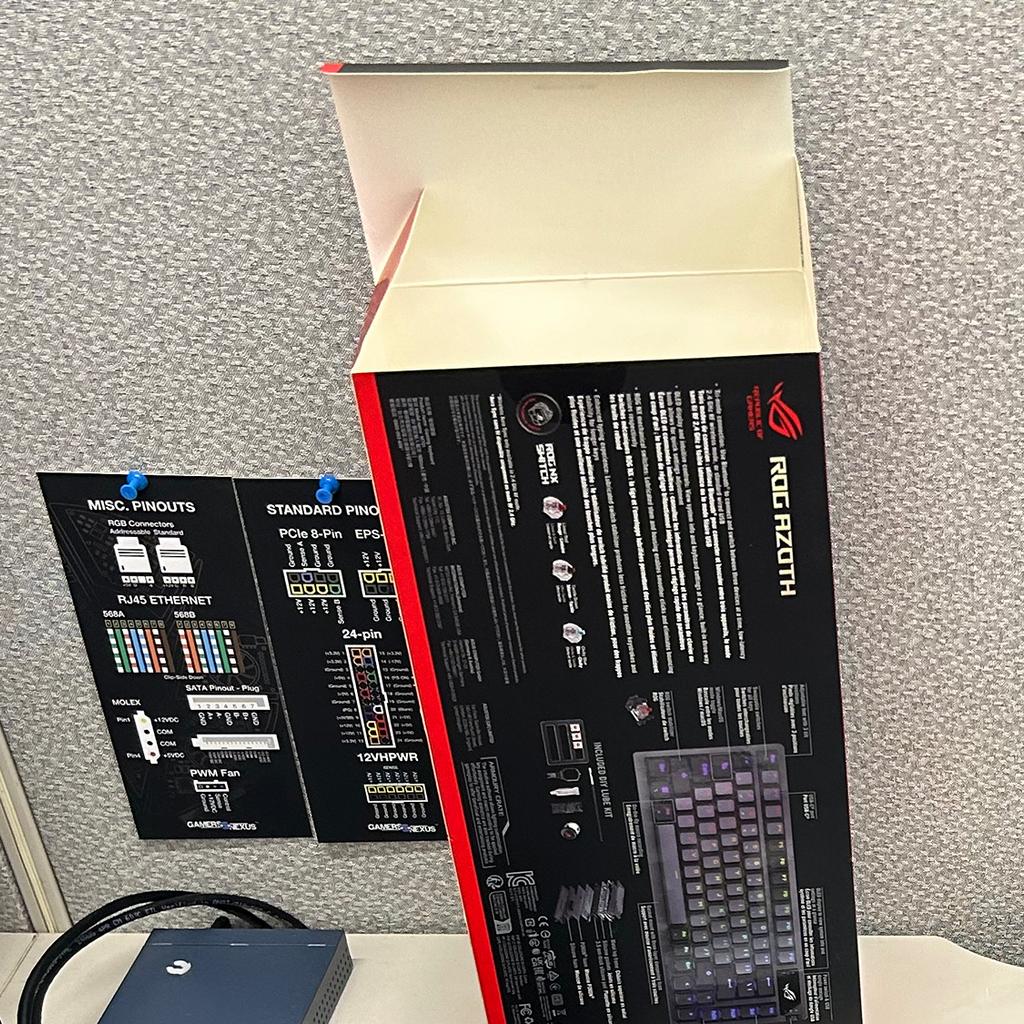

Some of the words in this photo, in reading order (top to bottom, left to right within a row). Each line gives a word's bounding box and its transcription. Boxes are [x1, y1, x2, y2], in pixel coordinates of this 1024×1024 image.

[769, 456, 789, 508] ROG
[87, 499, 129, 512] MISC.
[132, 500, 196, 513] PINOUTS
[266, 504, 342, 516] STANDARD
[107, 519, 127, 527] RGB
[128, 520, 174, 528] Connectors
[279, 529, 308, 539] PCIe
[311, 529, 343, 539] 8-Pin
[355, 529, 384, 539] EPS-
[284, 543, 296, 568] Ground
[310, 543, 322, 568] Ground
[323, 543, 335, 568] Ground
[773, 514, 795, 596] AZOTH
[117, 595, 147, 605] RJ45
[149, 595, 213, 605] ETHERNET
[102, 610, 125, 618] 568A
[342, 629, 383, 641] 24-pin
[241, 685, 260, 693] Plug
[357, 752, 418, 762] 12VHPWR
[593, 742, 606, 774] INCLUDED
[190, 769, 218, 777] PWM
[221, 769, 240, 777] Fan
[598, 776, 608, 787] DIY
[600, 788, 611, 805] LUBE
[603, 807, 613, 818] KIT
